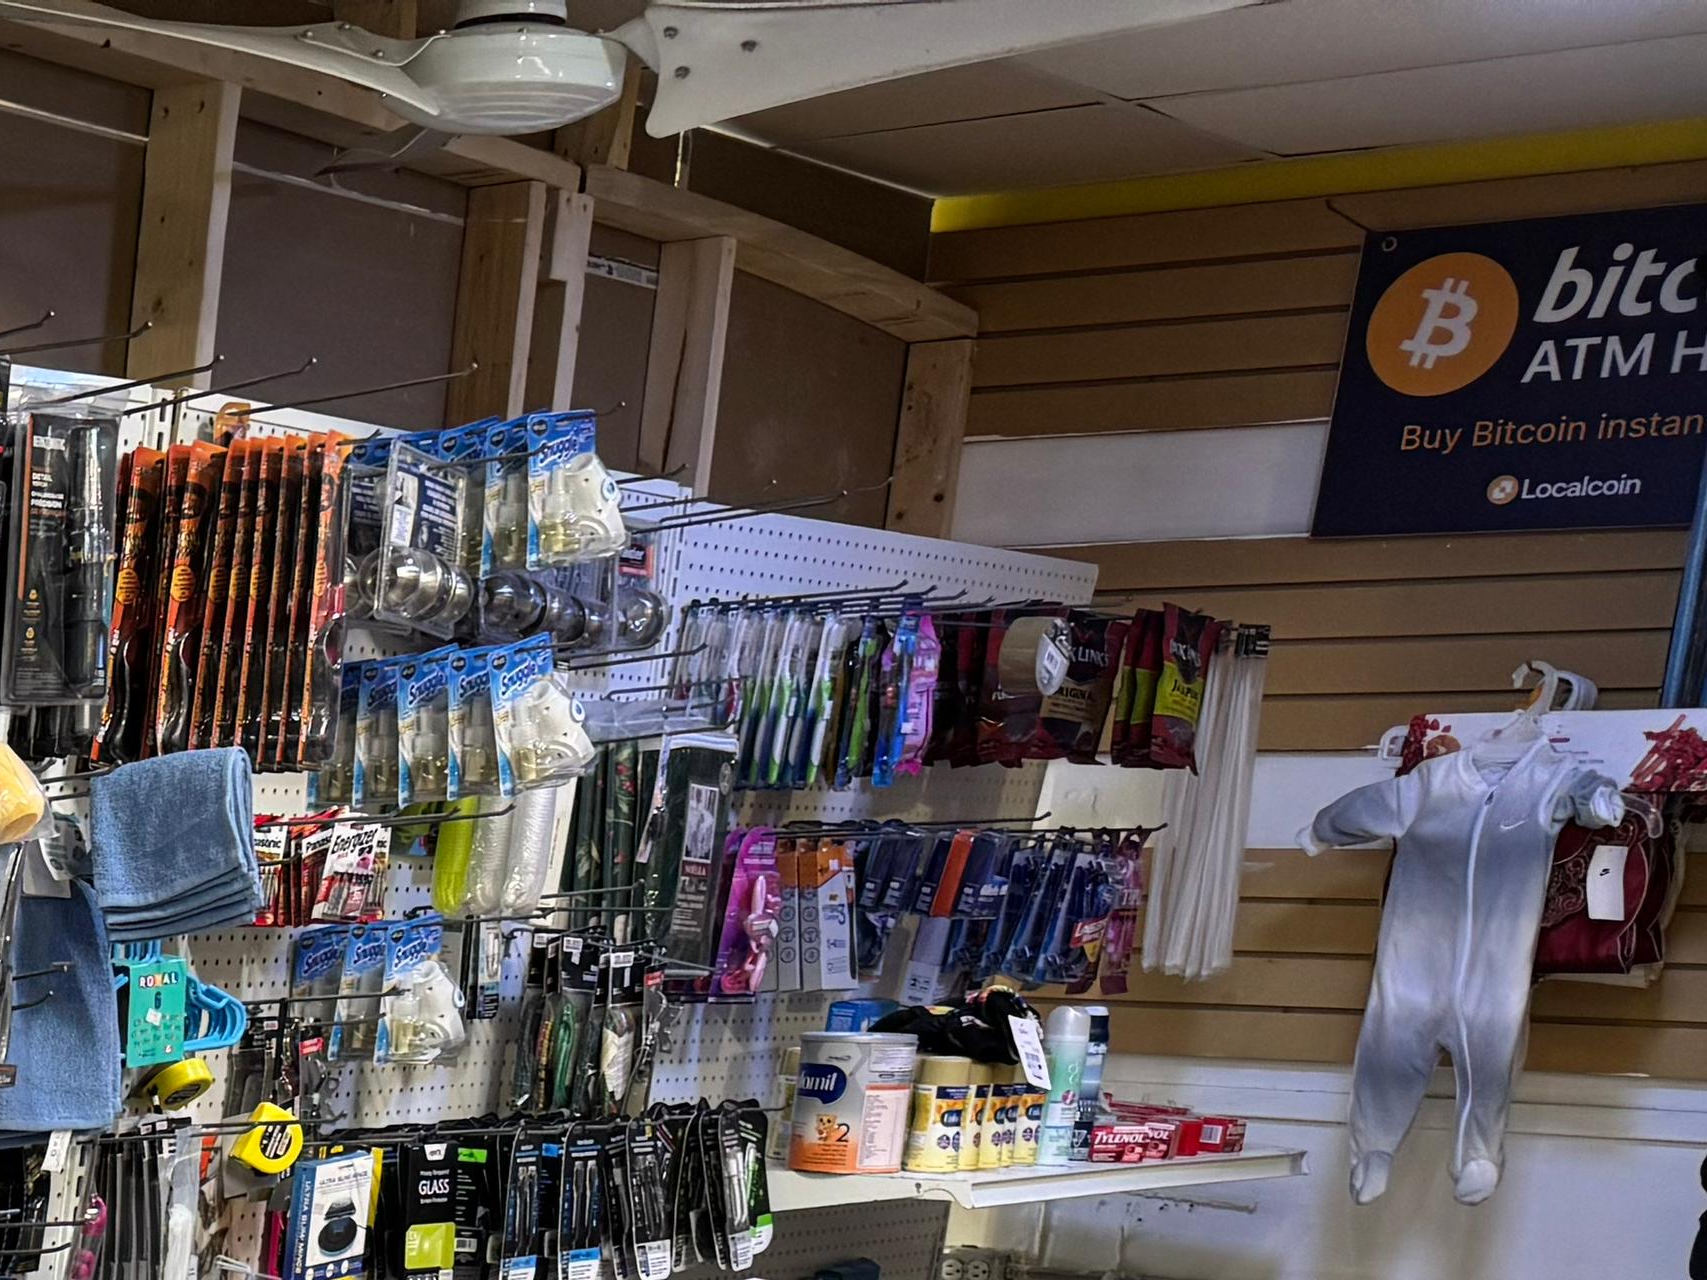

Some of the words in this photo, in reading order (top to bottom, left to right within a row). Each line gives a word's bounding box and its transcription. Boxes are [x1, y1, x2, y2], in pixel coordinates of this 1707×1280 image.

[1520, 332, 1655, 384] ATM
[1401, 424, 1461, 454] Buy
[1472, 415, 1586, 447] Bitcoin
[539, 436, 581, 463] Snuggle
[1521, 473, 1641, 499] Localcoin
[500, 661, 538, 695] Snuggle
[1094, 1130, 1148, 1145] TYLENOL
[418, 1178, 450, 1195] GLASS
